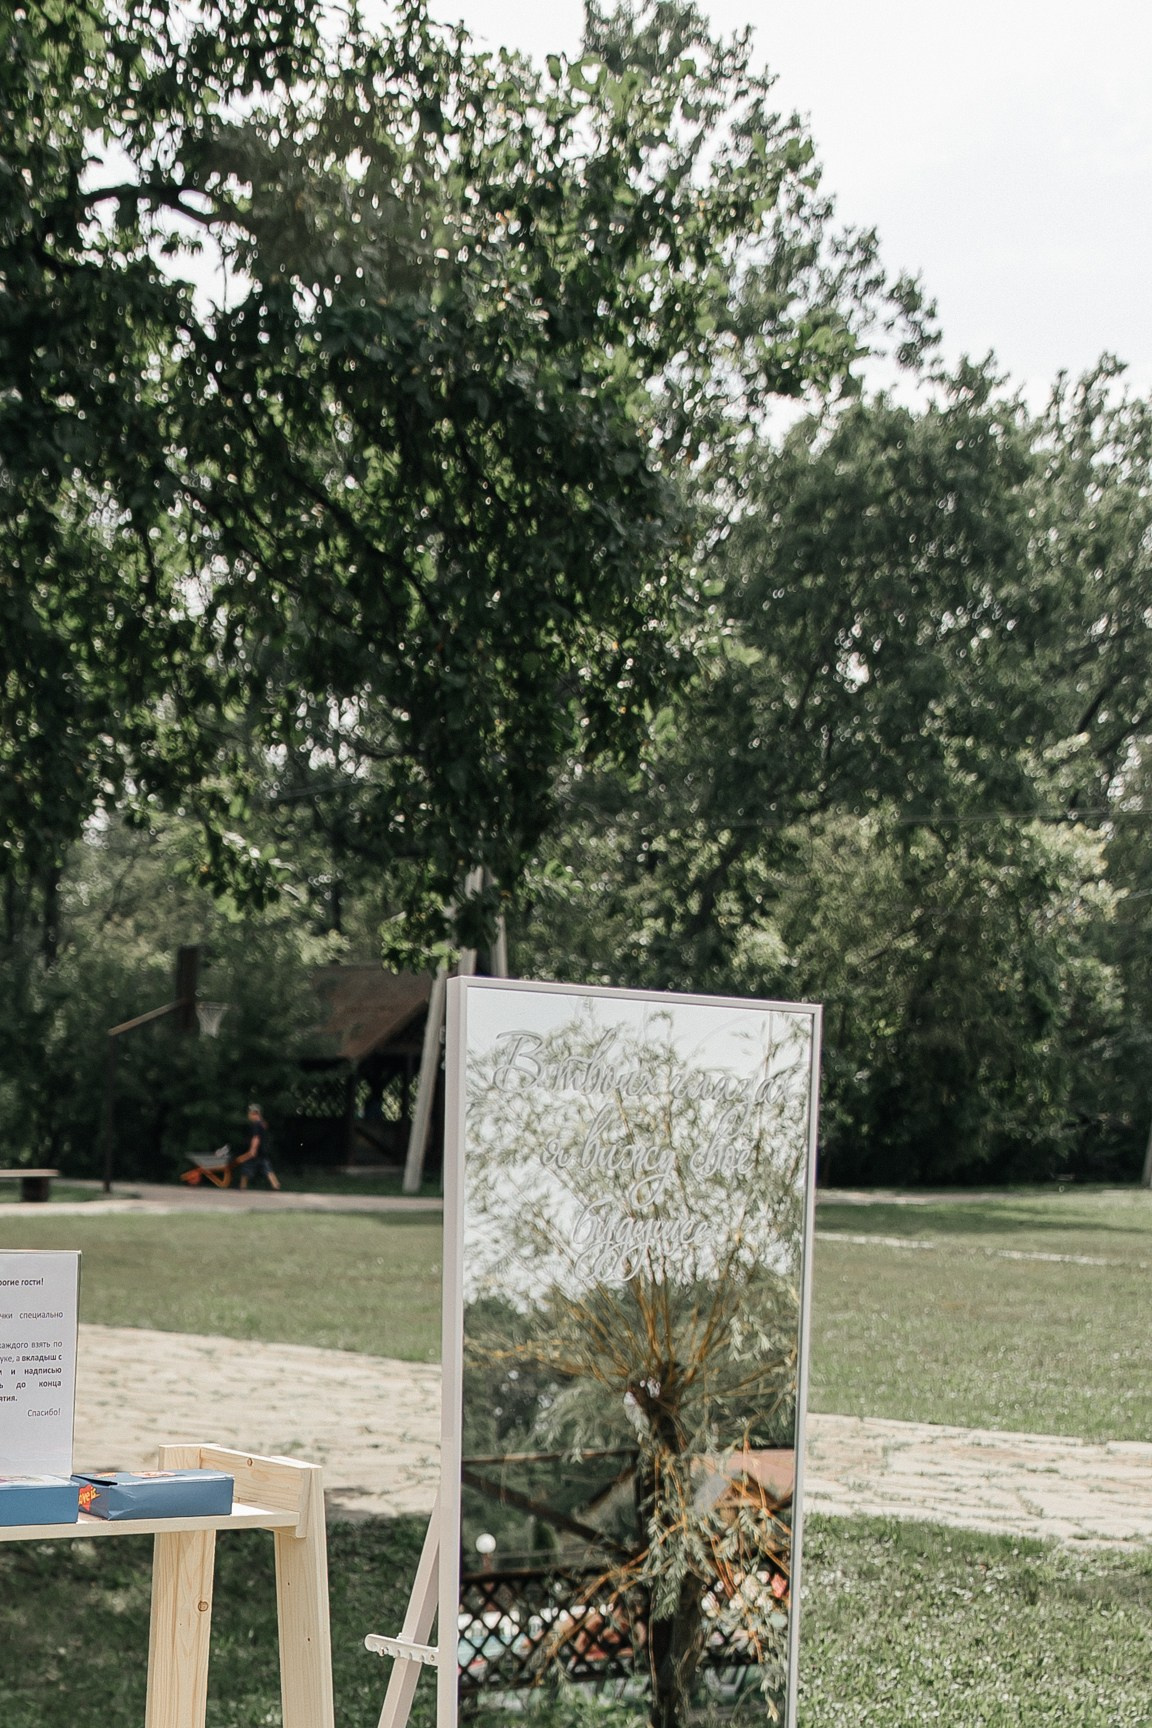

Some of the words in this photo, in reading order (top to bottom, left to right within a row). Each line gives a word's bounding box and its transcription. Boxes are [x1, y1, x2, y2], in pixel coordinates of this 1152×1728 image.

[21, 1278, 44, 1286] гости!
[24, 1367, 62, 1376] надписью
[28, 1408, 60, 1417] Спасибо!
